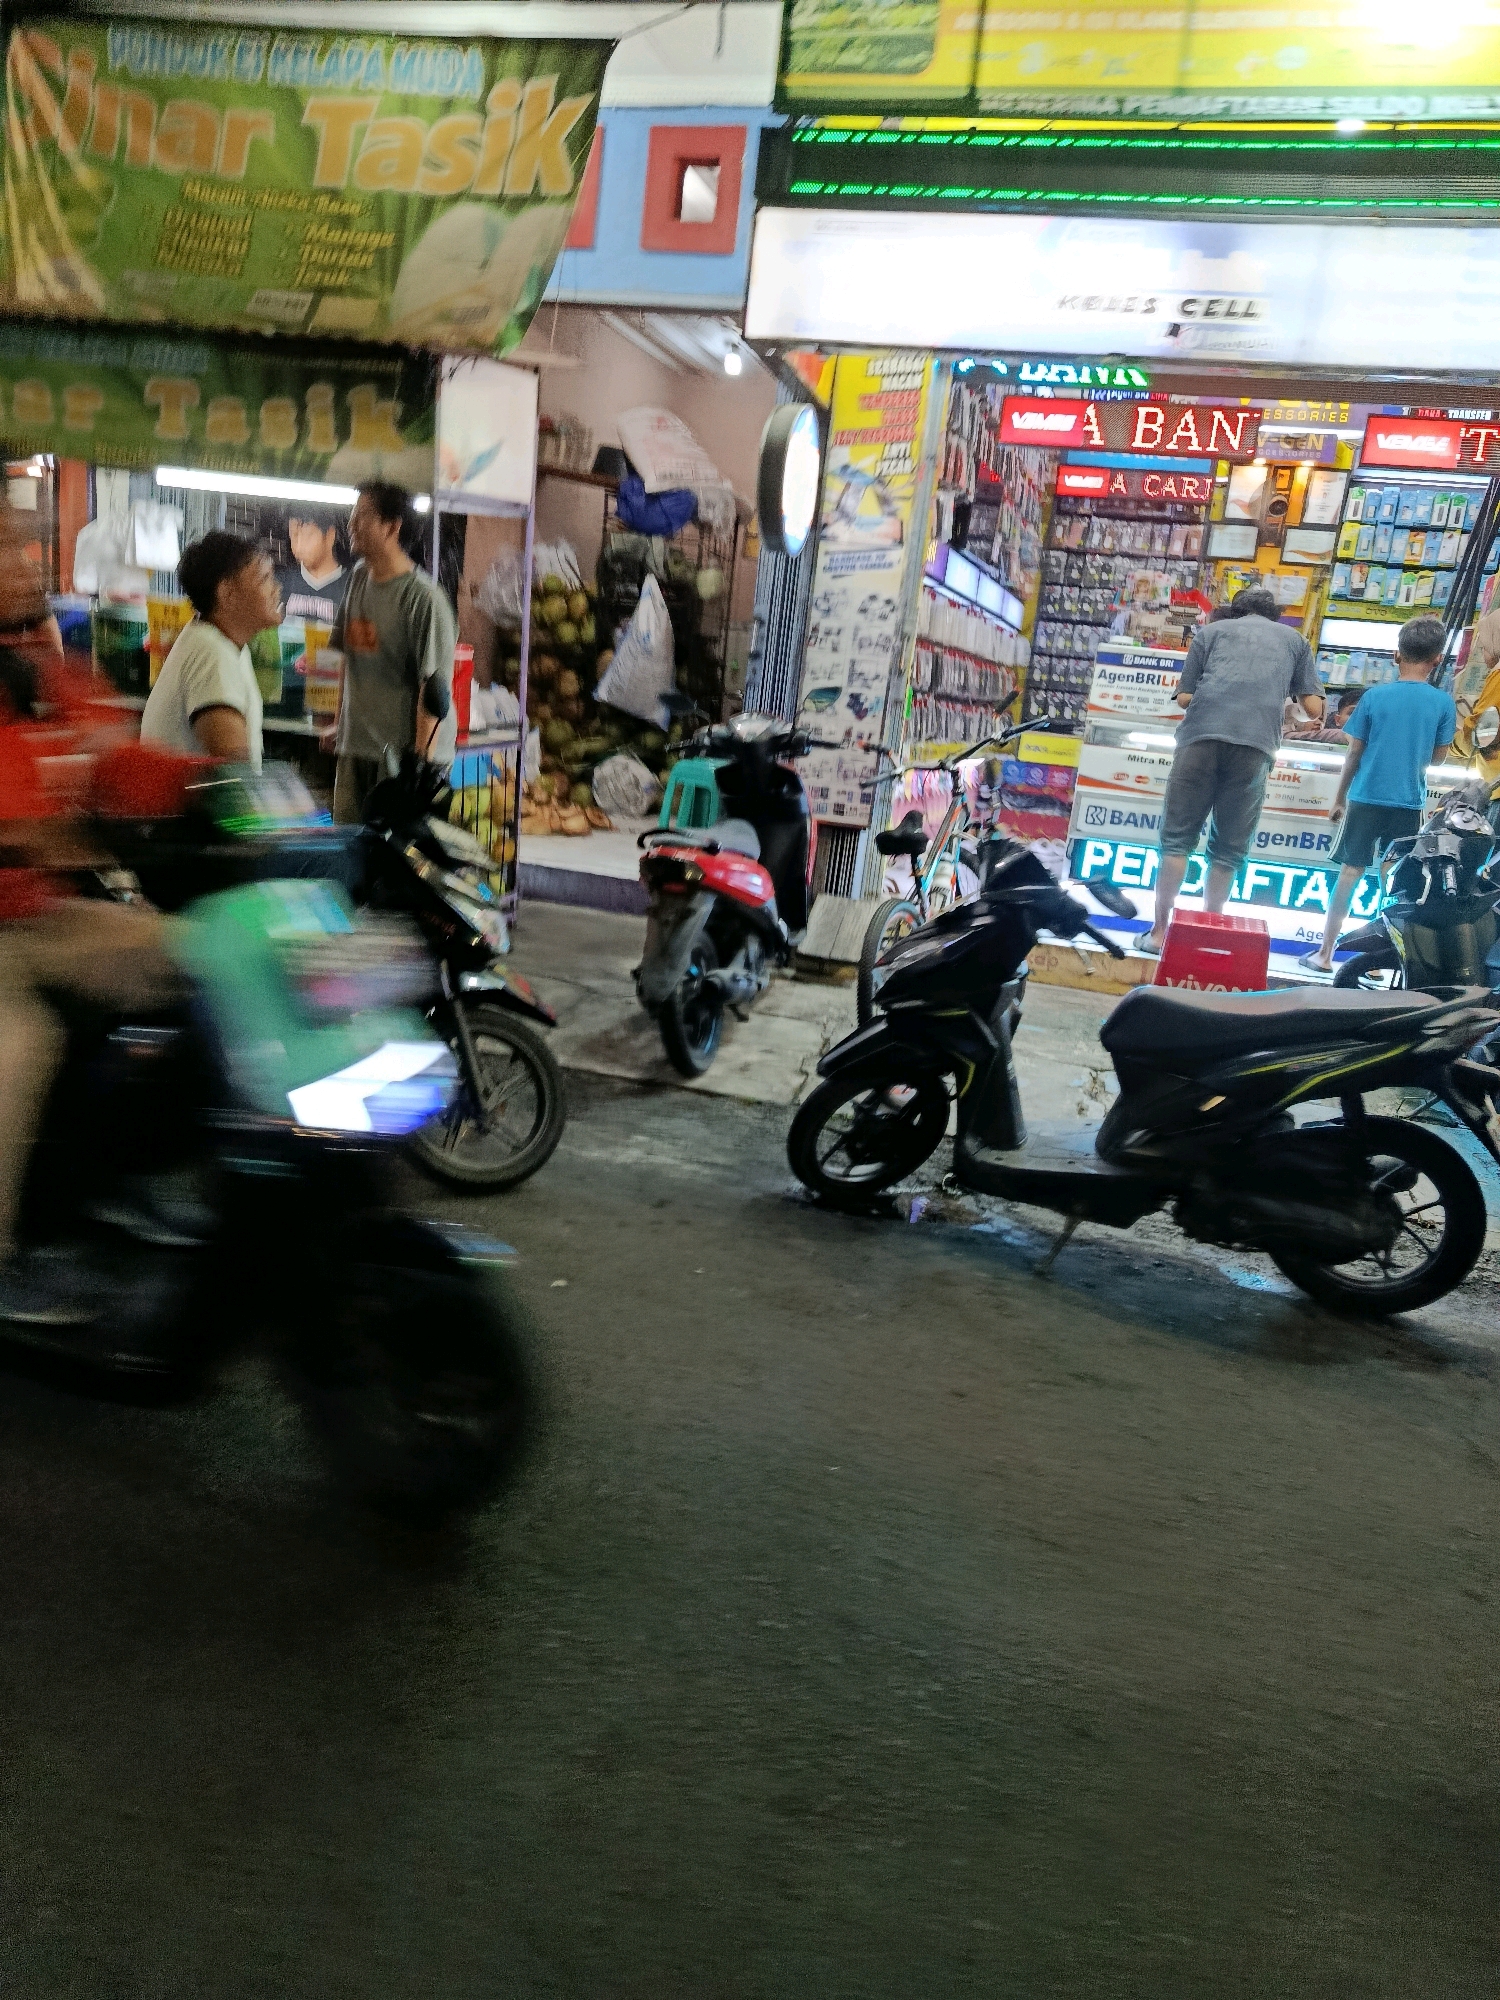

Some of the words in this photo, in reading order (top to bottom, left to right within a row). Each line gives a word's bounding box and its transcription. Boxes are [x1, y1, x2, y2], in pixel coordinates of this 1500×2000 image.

[301, 74, 596, 195] Tasik
[1180, 298, 1262, 320] CELL
[1263, 408, 1349, 423] ESSORIES
[1131, 405, 1262, 454] BAN
[1258, 448, 1322, 459] CCESSORIES
[1134, 655, 1159, 667] BANK
[1159, 659, 1175, 668] BRI
[1127, 754, 1155, 765] Mitra
[1158, 757, 1174, 767] Re
[1110, 809, 1162, 831] BAN
[1256, 831, 1333, 852] genBR
